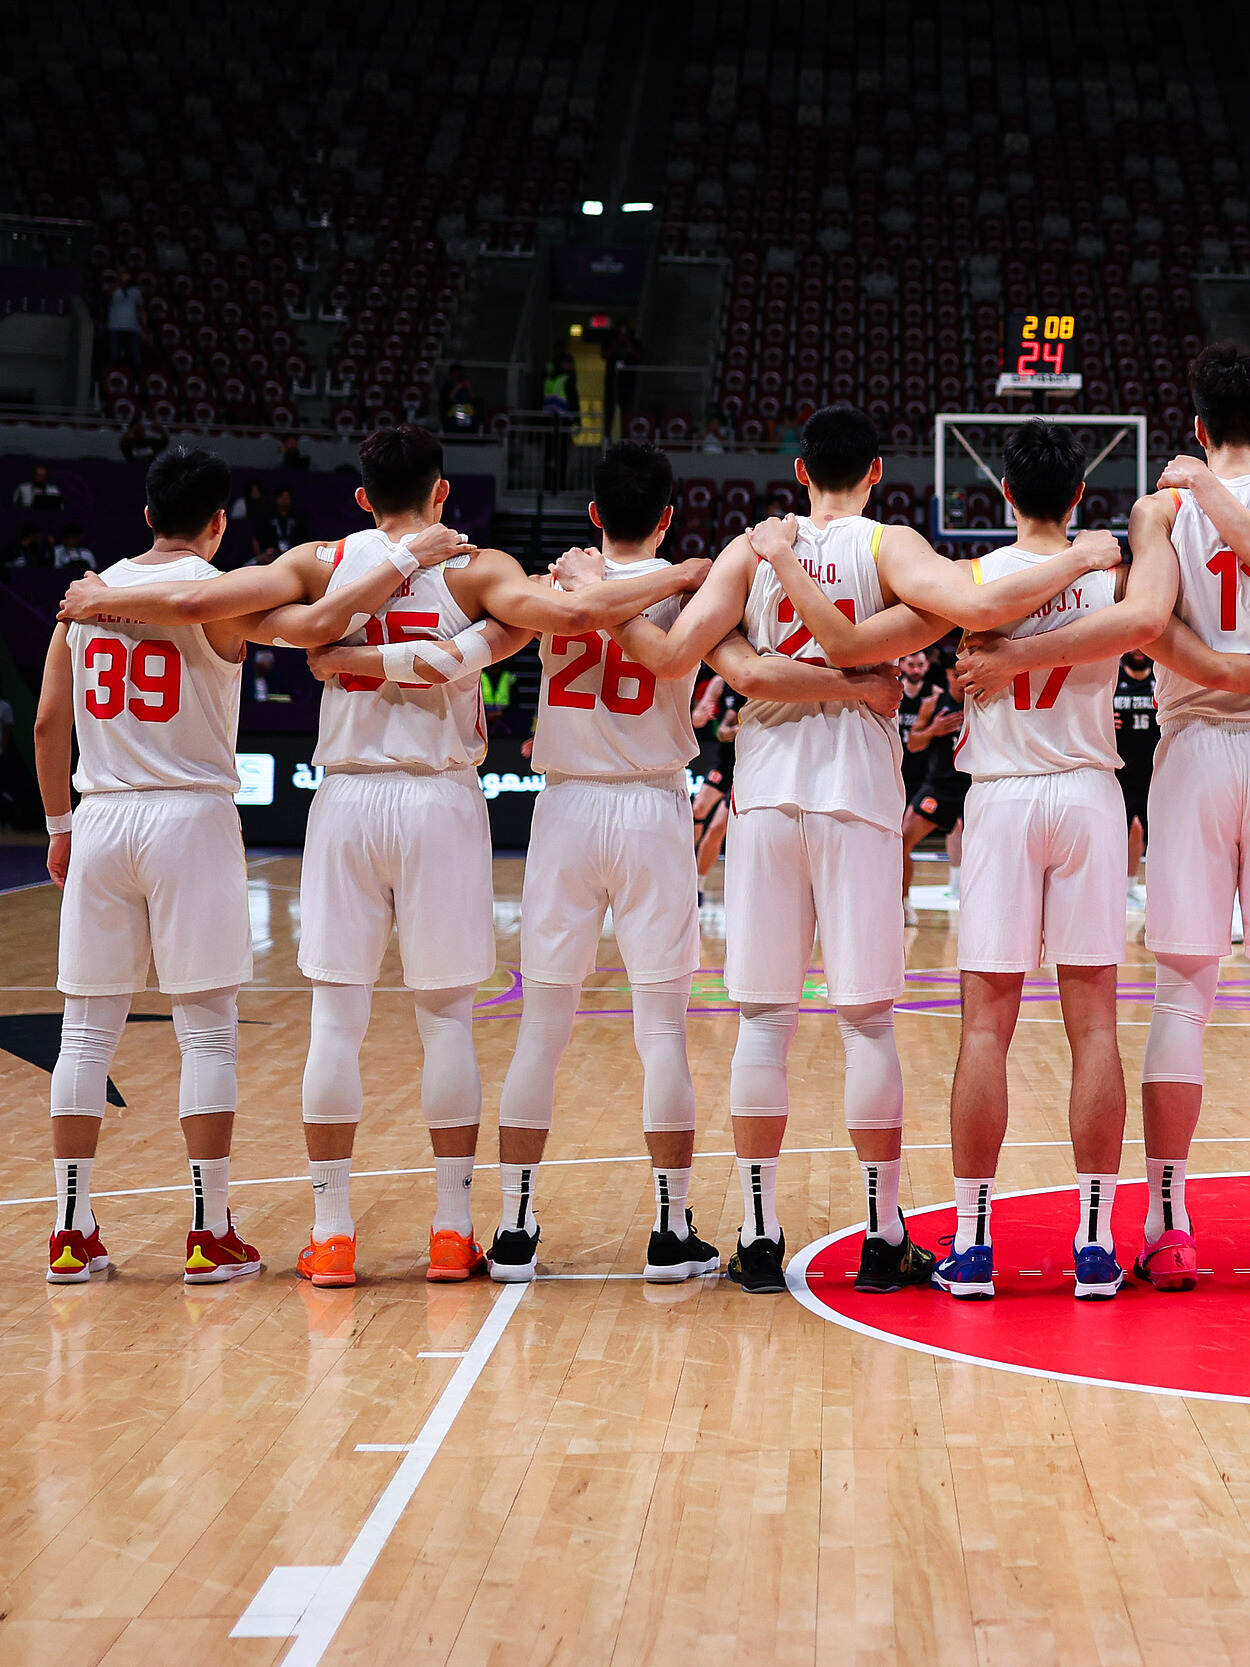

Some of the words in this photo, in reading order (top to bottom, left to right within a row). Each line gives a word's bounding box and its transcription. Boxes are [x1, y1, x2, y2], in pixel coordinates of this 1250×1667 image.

[1016, 340, 1065, 376] 24
[1056, 588, 1090, 613] J.Y.
[84, 637, 181, 723] 39
[547, 630, 657, 716] 26
[1132, 713, 1150, 729] 16
